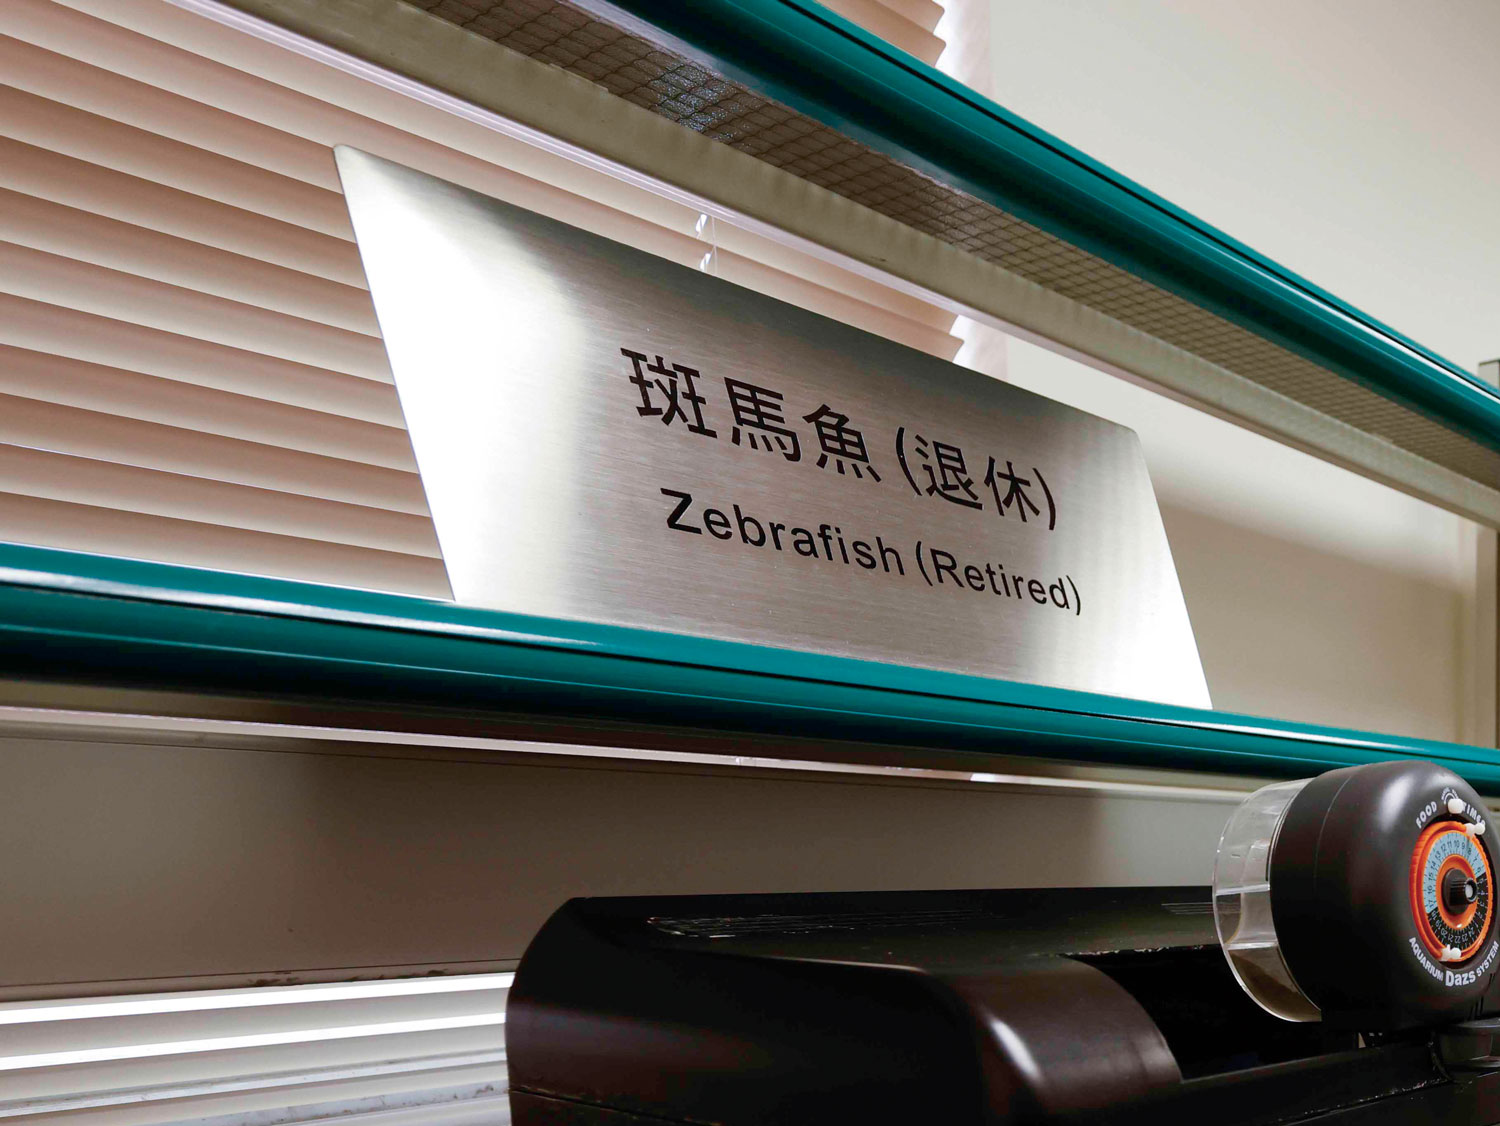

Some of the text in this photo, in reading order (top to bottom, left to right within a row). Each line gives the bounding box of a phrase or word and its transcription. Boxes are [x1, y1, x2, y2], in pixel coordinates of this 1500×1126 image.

[660, 487, 1082, 616] Zebrafish (Retired)
[1416, 801, 1437, 829] FOOD
[1409, 937, 1500, 987] AQUARIUM Dazs SYSTEM
